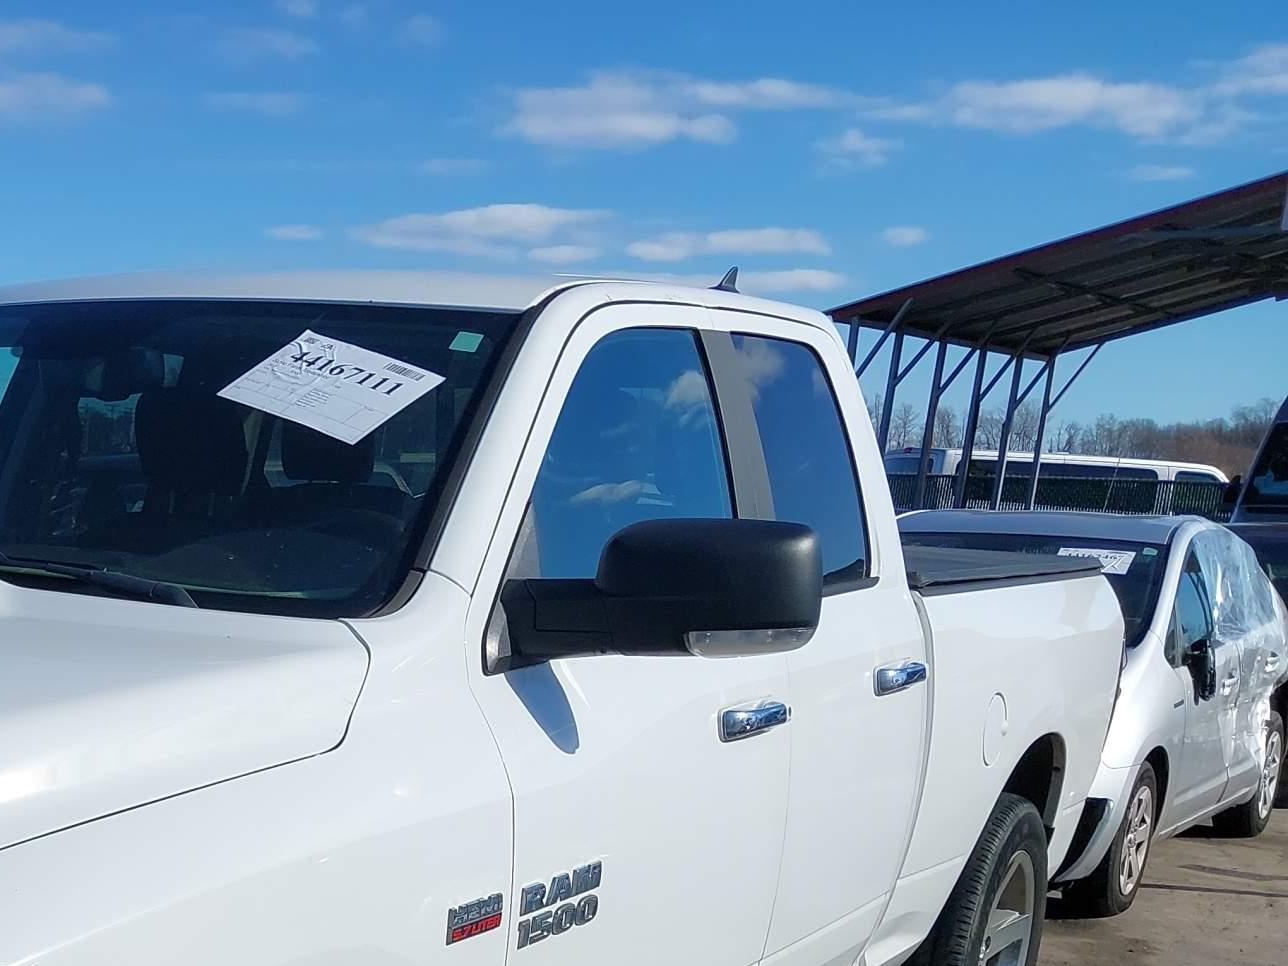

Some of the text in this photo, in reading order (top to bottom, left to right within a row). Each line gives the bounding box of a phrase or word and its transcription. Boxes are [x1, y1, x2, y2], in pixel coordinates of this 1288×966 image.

[289, 350, 405, 396] 44167111
[519, 859, 603, 917] RAM
[516, 894, 599, 950] 1500
